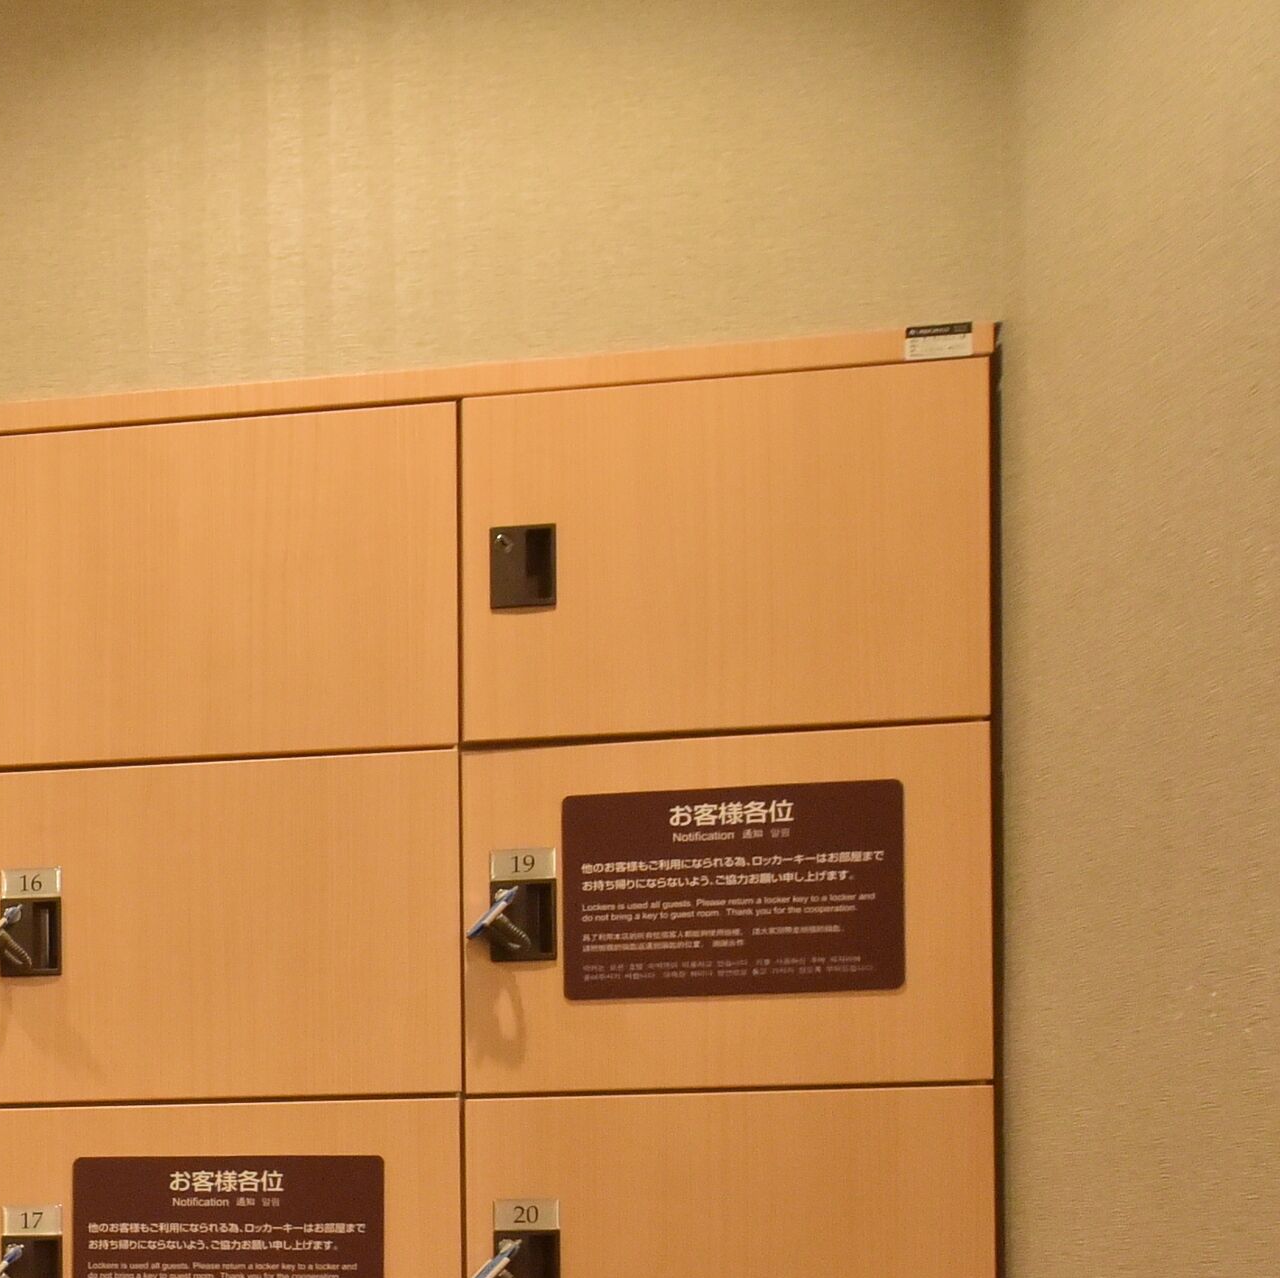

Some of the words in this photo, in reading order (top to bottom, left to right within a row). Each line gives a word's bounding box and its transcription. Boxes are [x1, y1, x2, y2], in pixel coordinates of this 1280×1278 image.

[668, 798, 794, 828] お客様各位
[672, 829, 734, 842] Notification
[511, 855, 535, 873] 19
[20, 874, 42, 891] 16
[169, 1169, 284, 1192] お客様各位
[172, 1197, 229, 1206] Notification
[20, 1212, 43, 1229] 17
[513, 1205, 539, 1224] 20
